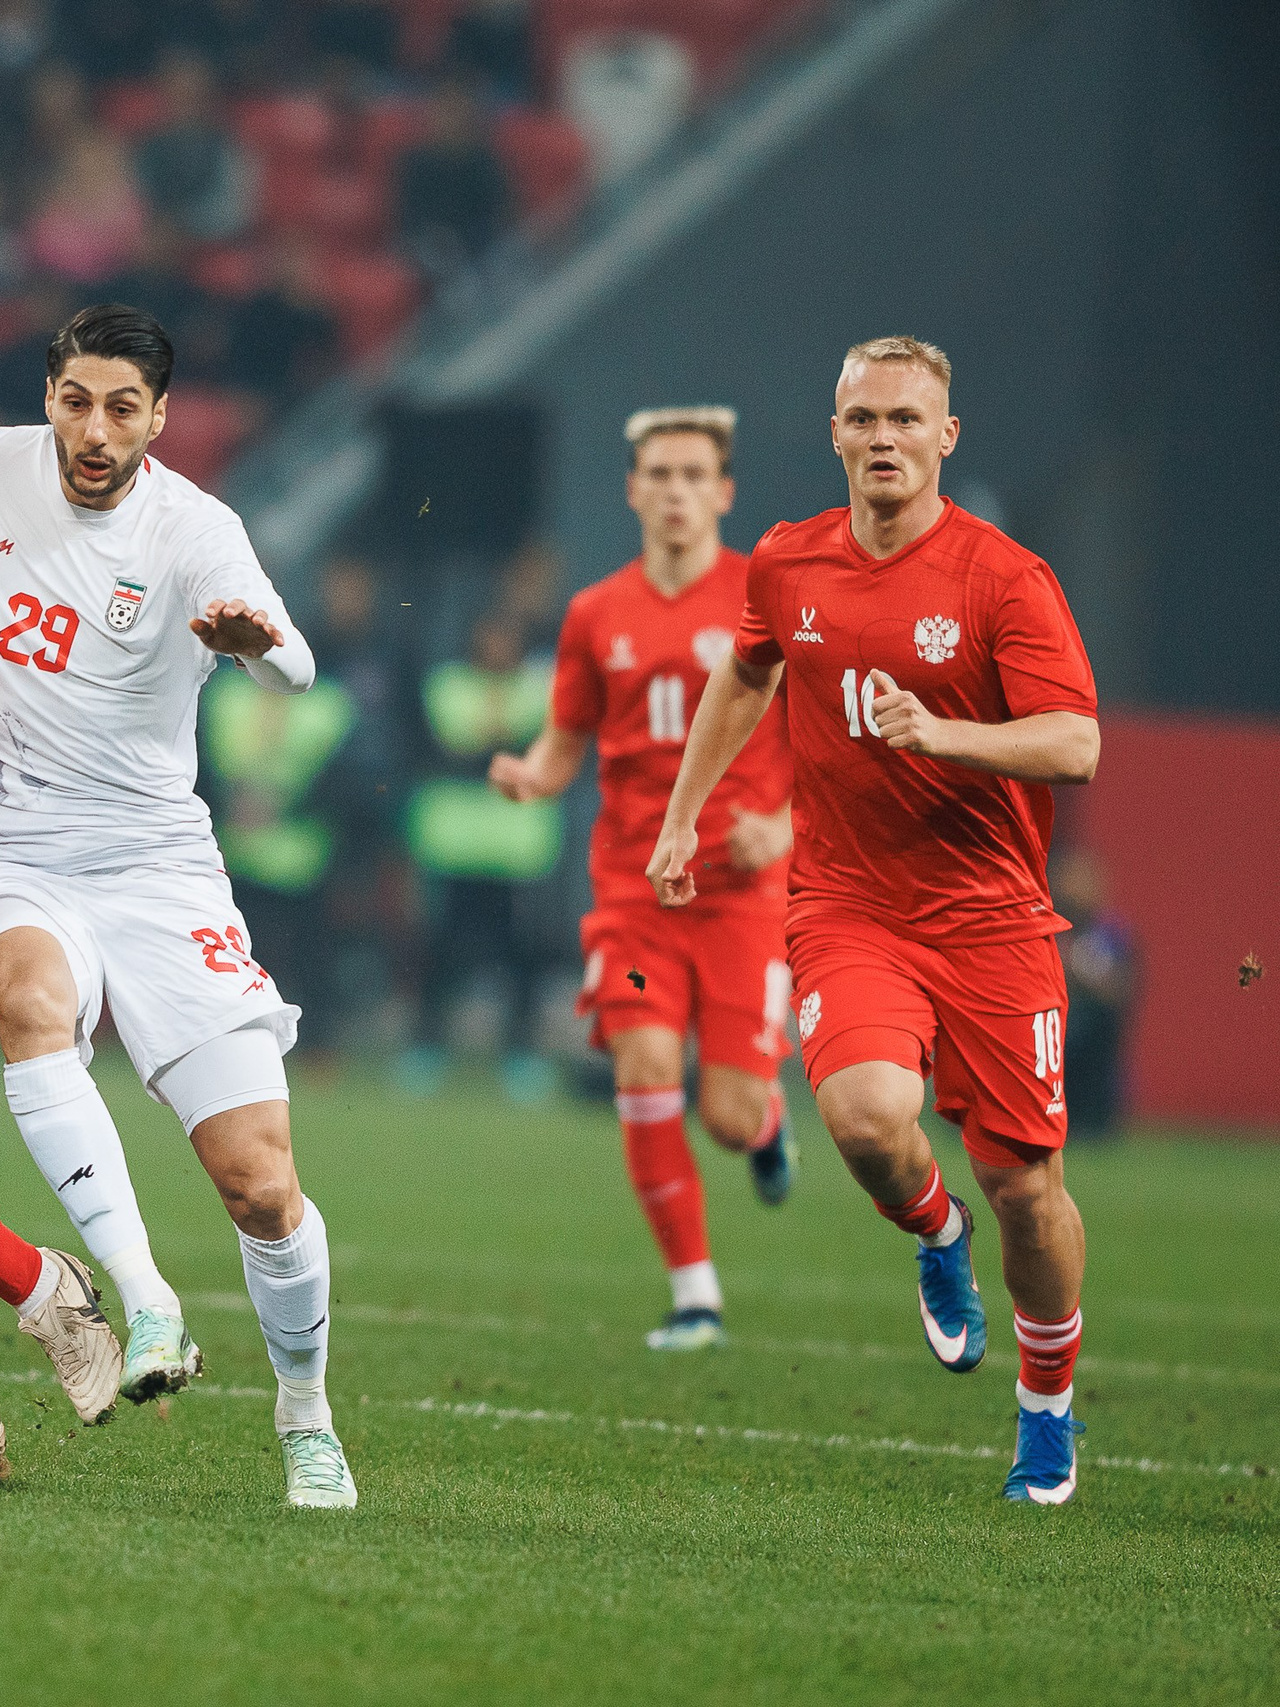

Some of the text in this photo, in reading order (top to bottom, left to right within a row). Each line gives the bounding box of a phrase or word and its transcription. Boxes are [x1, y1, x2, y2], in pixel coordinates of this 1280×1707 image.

[647, 674, 685, 742] 11
[840, 668, 898, 738] 10
[1031, 1008, 1061, 1078] 10
